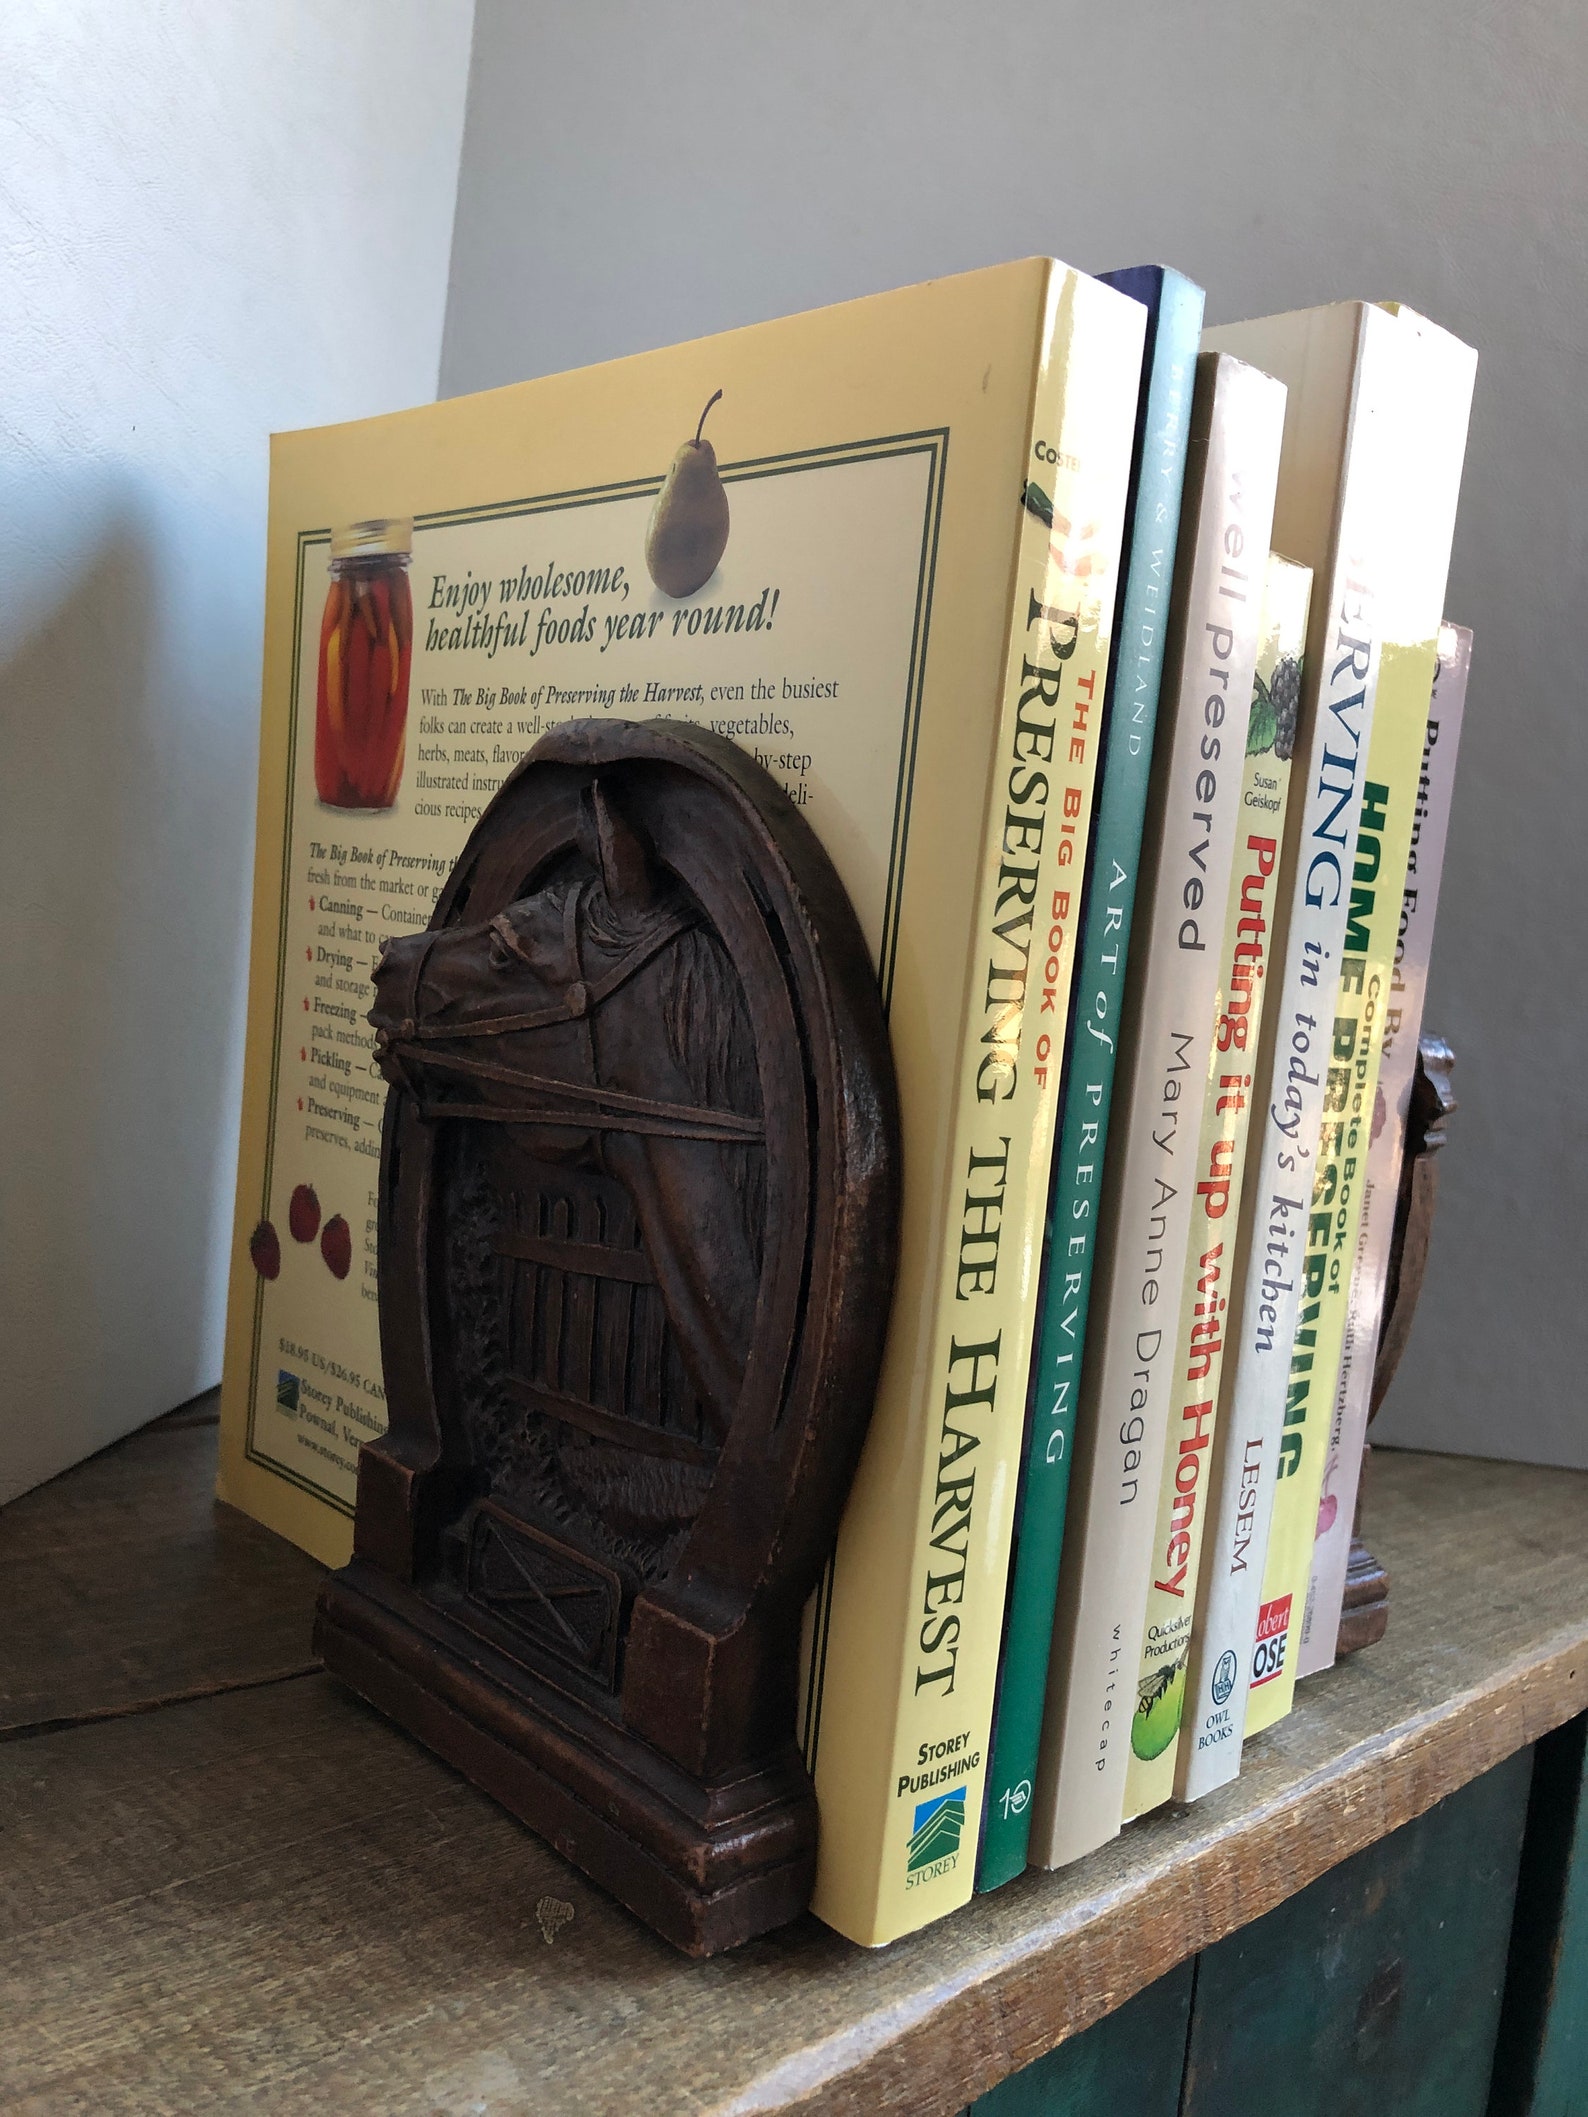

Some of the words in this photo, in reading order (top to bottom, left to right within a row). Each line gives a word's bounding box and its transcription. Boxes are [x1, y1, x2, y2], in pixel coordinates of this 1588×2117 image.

[1156, 502, 1168, 523] &
[428, 571, 492, 617] Enjoy
[499, 561, 630, 603] wholesome,
[425, 609, 530, 659] healthful
[530, 604, 597, 657] foods
[600, 611, 664, 653] year
[672, 587, 781, 637] round!
[1128, 549, 1163, 756] WEIDLAND
[422, 688, 447, 706] With
[453, 687, 472, 706] The
[475, 687, 497, 710] Big
[500, 687, 528, 706] Book
[530, 685, 545, 709] of
[545, 683, 615, 709] Preserving
[619, 683, 640, 703] the
[643, 682, 704, 705] Harvest,
[710, 684, 745, 701] even
[751, 678, 775, 700] the
[782, 676, 840, 699] busiest
[419, 715, 445, 734] folks
[448, 722, 466, 734] can
[470, 719, 504, 734] create
[507, 722, 513, 734] a
[710, 713, 795, 740] vegetables,
[1069, 669, 1096, 764] THE
[418, 744, 450, 764] herbs,
[453, 748, 488, 764] meats,
[416, 771, 469, 790] illustrated
[472, 774, 503, 791] instru
[1178, 622, 1233, 951] preserved
[1253, 772, 1277, 791] Susan
[414, 799, 442, 816] cious
[445, 800, 482, 823] recipes
[1058, 787, 1082, 867] BIG
[310, 842, 326, 859] The
[330, 844, 348, 865] Big
[351, 846, 373, 864] Book
[376, 849, 388, 870] of
[389, 850, 446, 876] Preserving
[976, 587, 1080, 1106] PRESERVING
[307, 866, 331, 885] fresh
[333, 869, 357, 889] from
[360, 873, 376, 891] the
[379, 877, 414, 895] market
[417, 885, 429, 897] or
[1340, 781, 1389, 995] HOME
[319, 895, 364, 921] Canning
[1101, 858, 1127, 975] ART
[318, 921, 336, 937] and
[339, 923, 361, 941] what
[365, 928, 376, 944] to
[1040, 890, 1071, 1014] BOOK
[1216, 835, 1277, 1052] Putting
[317, 946, 353, 972] Drying
[1301, 941, 1330, 987] in
[315, 973, 333, 989] and
[336, 978, 370, 1000] storage
[312, 1023, 333, 1041] pack
[314, 996, 357, 1025] Freezing
[1087, 991, 1114, 1054] of
[311, 1047, 352, 1076] Pickling
[1033, 1034, 1052, 1090] OF
[308, 1074, 327, 1089] and
[329, 1081, 381, 1106] equipment
[1153, 1032, 1194, 1156] Mary
[1215, 1074, 1251, 1116] it
[1271, 1012, 1320, 1172] today's
[307, 1096, 360, 1131] Preserving
[305, 1125, 351, 1151] preserves,
[354, 1138, 381, 1159] addin
[1197, 1140, 1234, 1219] up
[956, 1136, 1012, 1301] THE
[1333, 1157, 1356, 1253] Book
[1142, 1178, 1177, 1306] Anne
[1046, 1083, 1103, 1464] PRESERVING
[1255, 1195, 1304, 1354] kitchen
[1328, 1259, 1340, 1294] of
[1187, 1242, 1226, 1381] with
[301, 1378, 333, 1411] Storey
[300, 1403, 338, 1440] Pownal,
[1120, 1329, 1161, 1505] Dragan
[914, 1328, 1002, 1698] HARVEST
[1154, 1400, 1213, 1597] Honey
[1231, 1437, 1263, 1576] LESEM
[1148, 1614, 1192, 1640] Quicksilver
[1256, 1603, 1289, 1638] obert
[1144, 1632, 1191, 1658] Productions
[1253, 1633, 1287, 1678] OSE
[1095, 1624, 1121, 1771] whitecap
[1206, 1709, 1230, 1729] OWL
[917, 1731, 970, 1765] STOREY
[1198, 1723, 1233, 1750] BOOKS
[897, 1751, 980, 1797] PUBLISHING
[905, 1853, 959, 1890] STOREY
